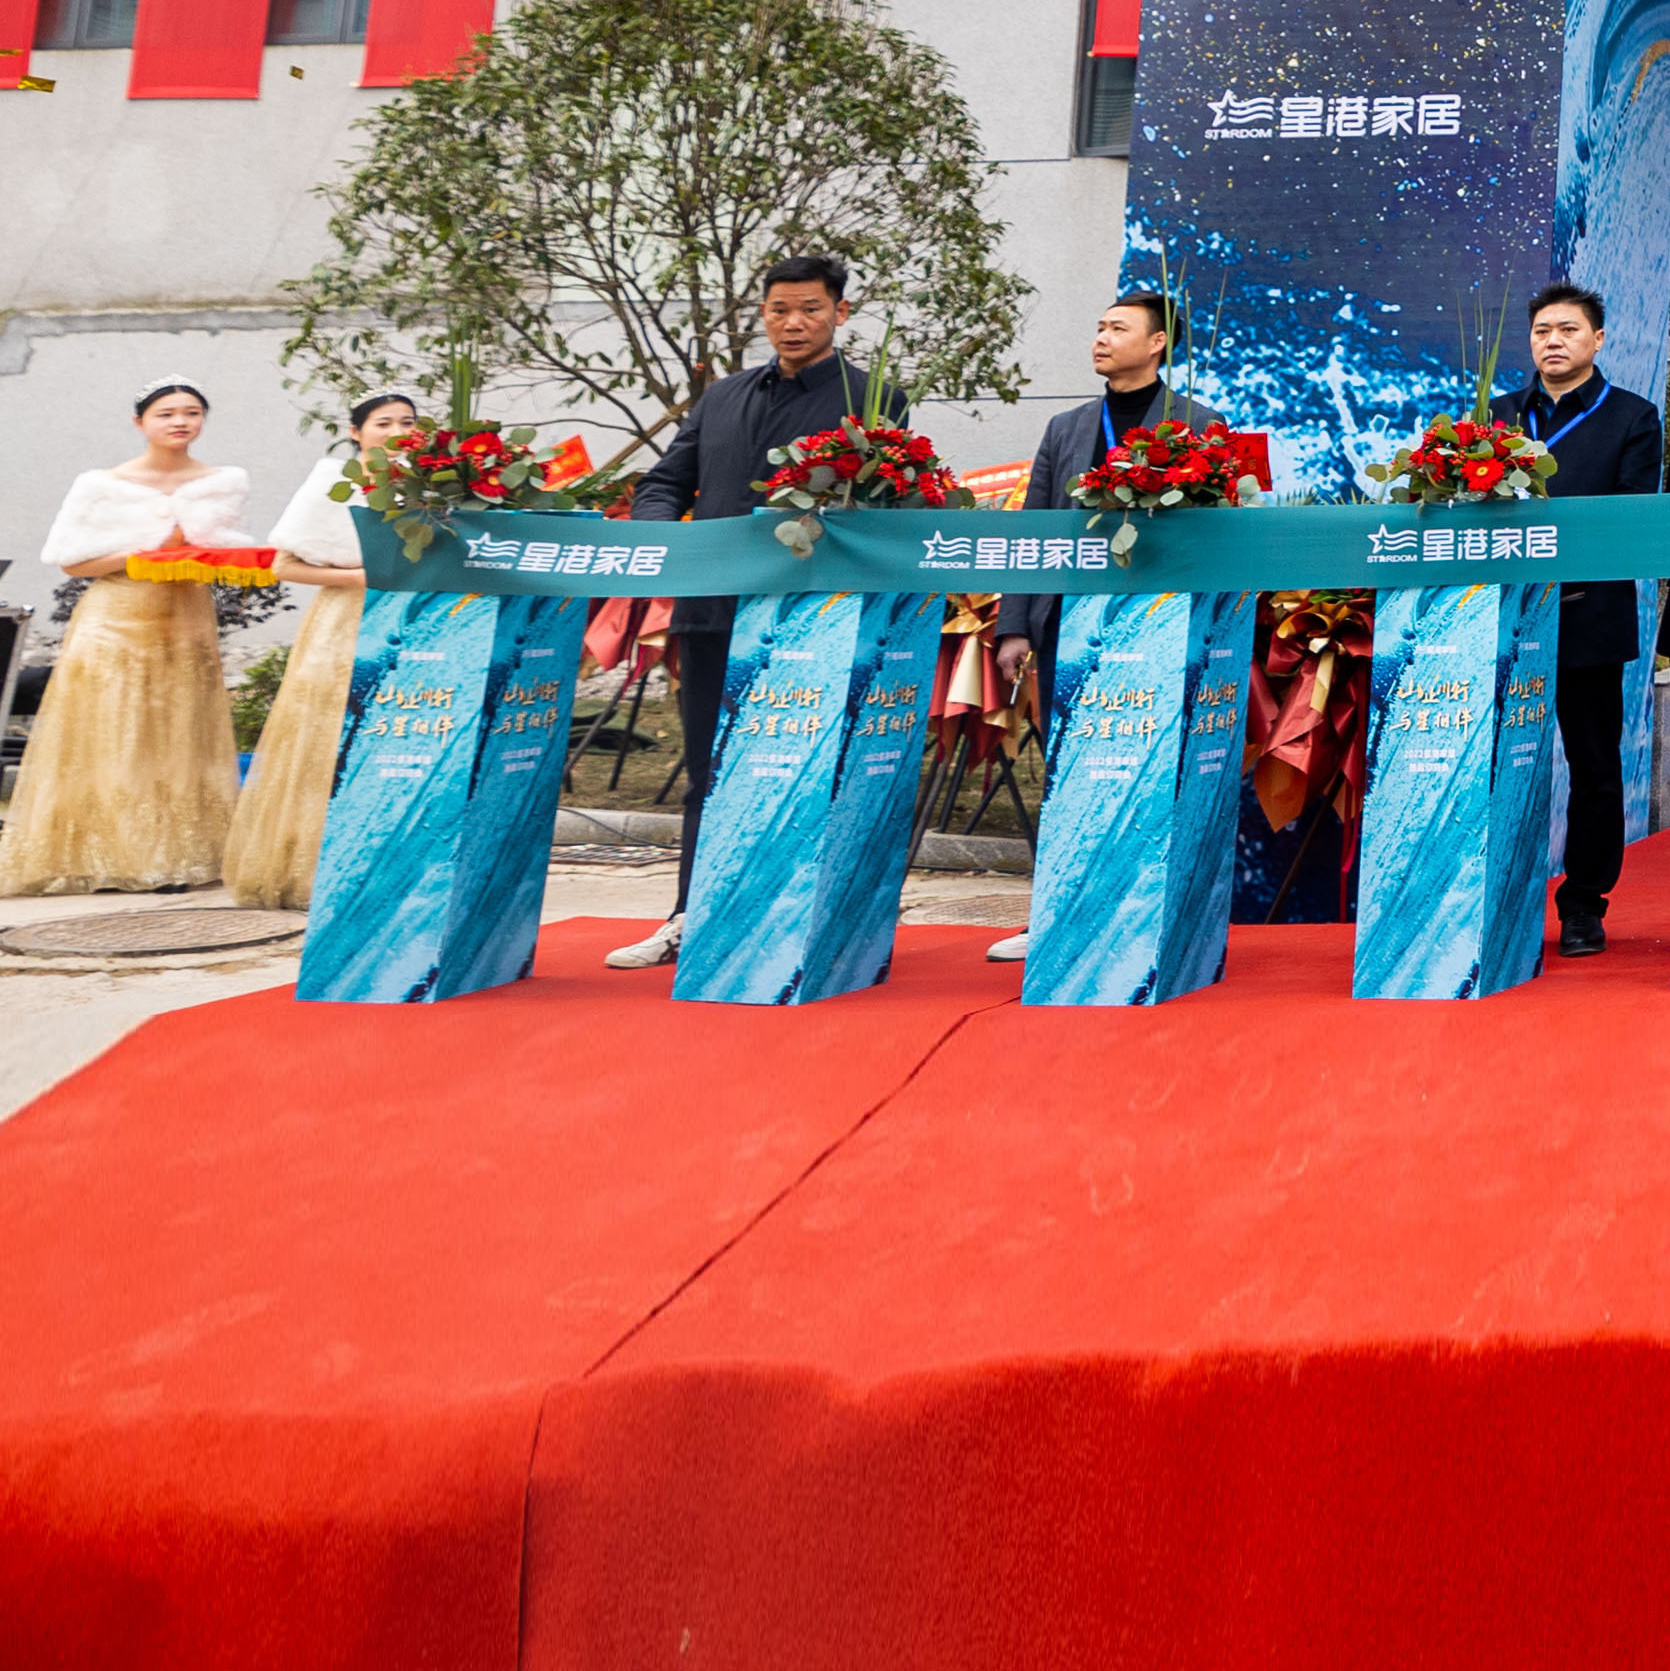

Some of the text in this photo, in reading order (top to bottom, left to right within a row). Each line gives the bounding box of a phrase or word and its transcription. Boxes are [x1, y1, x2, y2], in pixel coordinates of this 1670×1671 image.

[1205, 127, 1273, 139] STARDOM
[1280, 94, 1462, 138] 星港家居
[516, 543, 668, 576] 星港家居
[975, 537, 1109, 571] 星港家居
[1423, 525, 1558, 561] 星港家居
